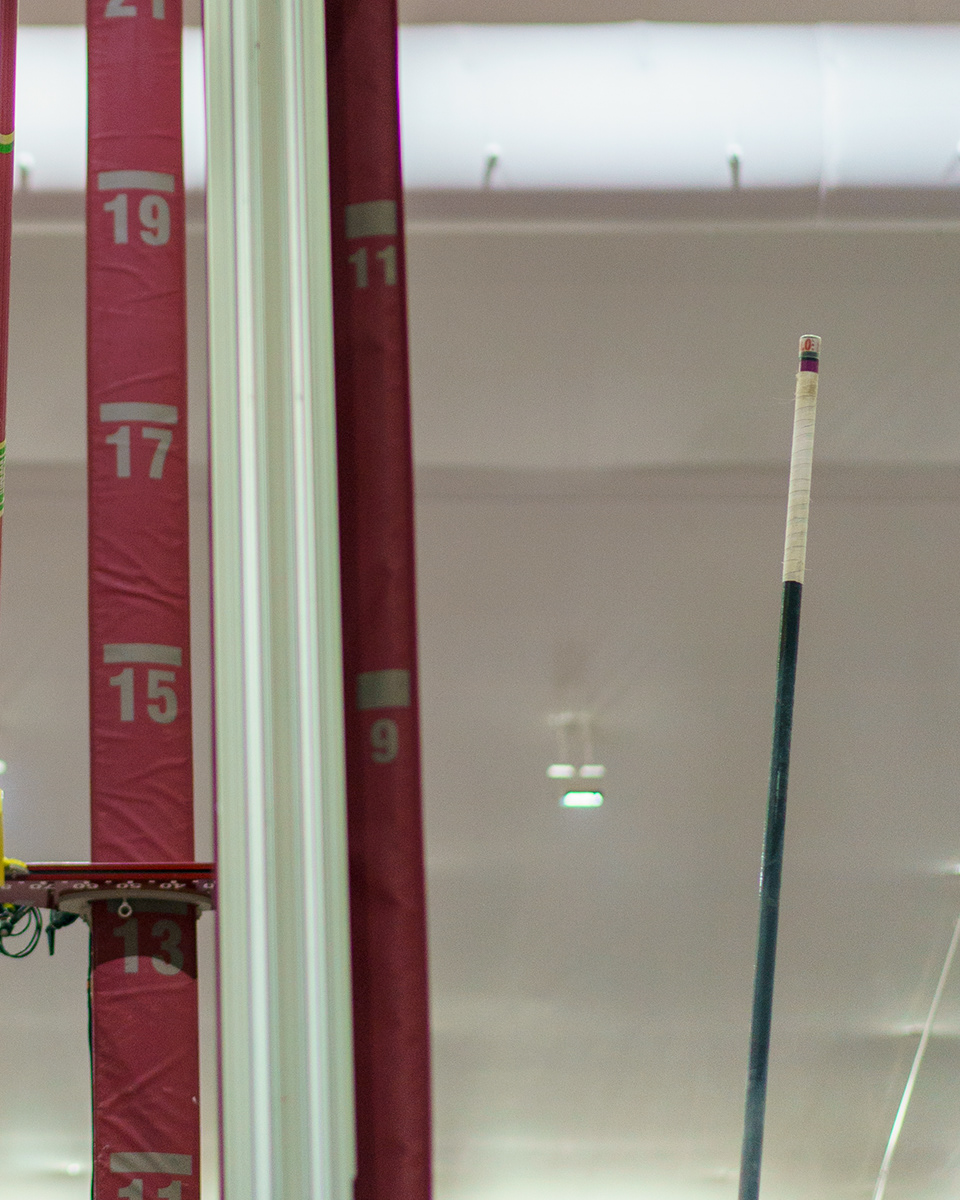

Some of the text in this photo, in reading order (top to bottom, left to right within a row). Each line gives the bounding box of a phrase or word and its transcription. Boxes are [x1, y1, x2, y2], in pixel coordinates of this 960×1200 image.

[103, 193, 172, 246] 19
[348, 245, 397, 289] 11
[105, 425, 175, 479] 17
[109, 667, 179, 725] 15
[369, 717, 400, 764] 9
[113, 919, 185, 976] 13
